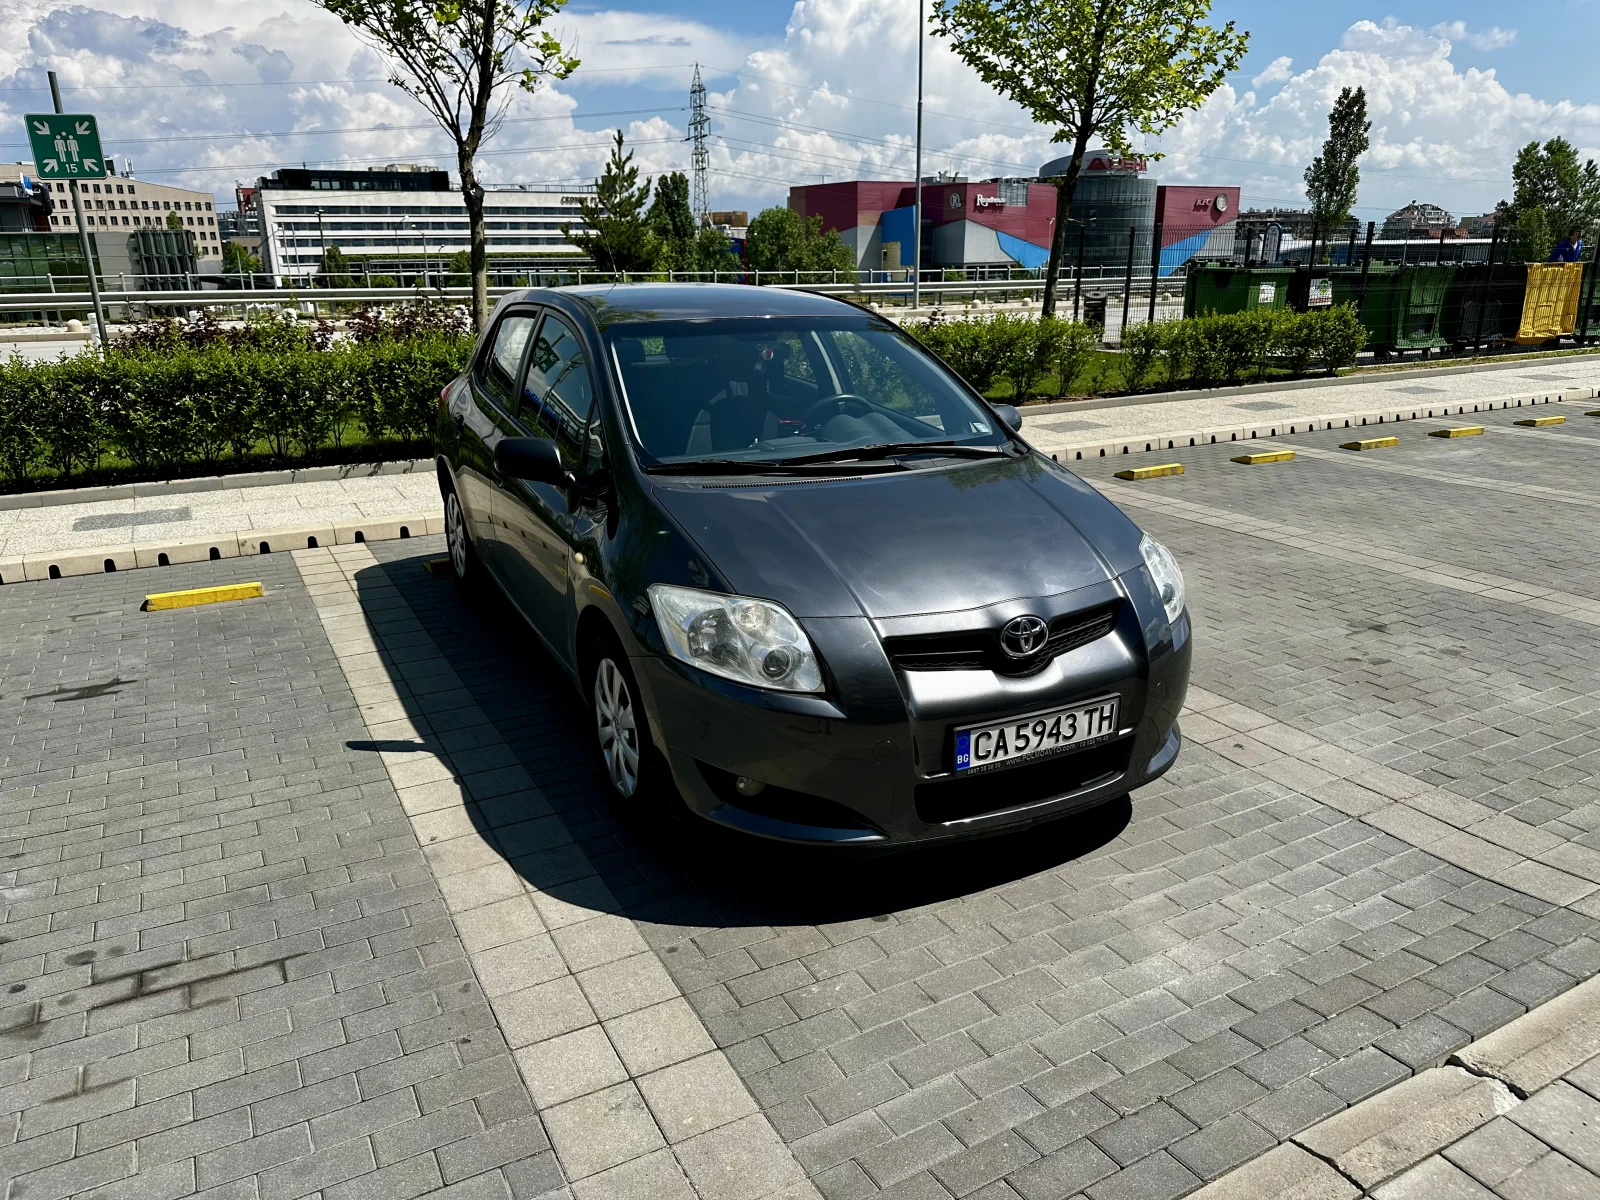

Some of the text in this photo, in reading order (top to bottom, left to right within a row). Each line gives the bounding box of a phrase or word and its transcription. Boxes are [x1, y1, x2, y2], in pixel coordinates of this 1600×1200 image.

[65, 163, 78, 173] 15
[560, 196, 588, 204] CROWE
[1195, 198, 1212, 206] KFC
[957, 753, 969, 764] BG
